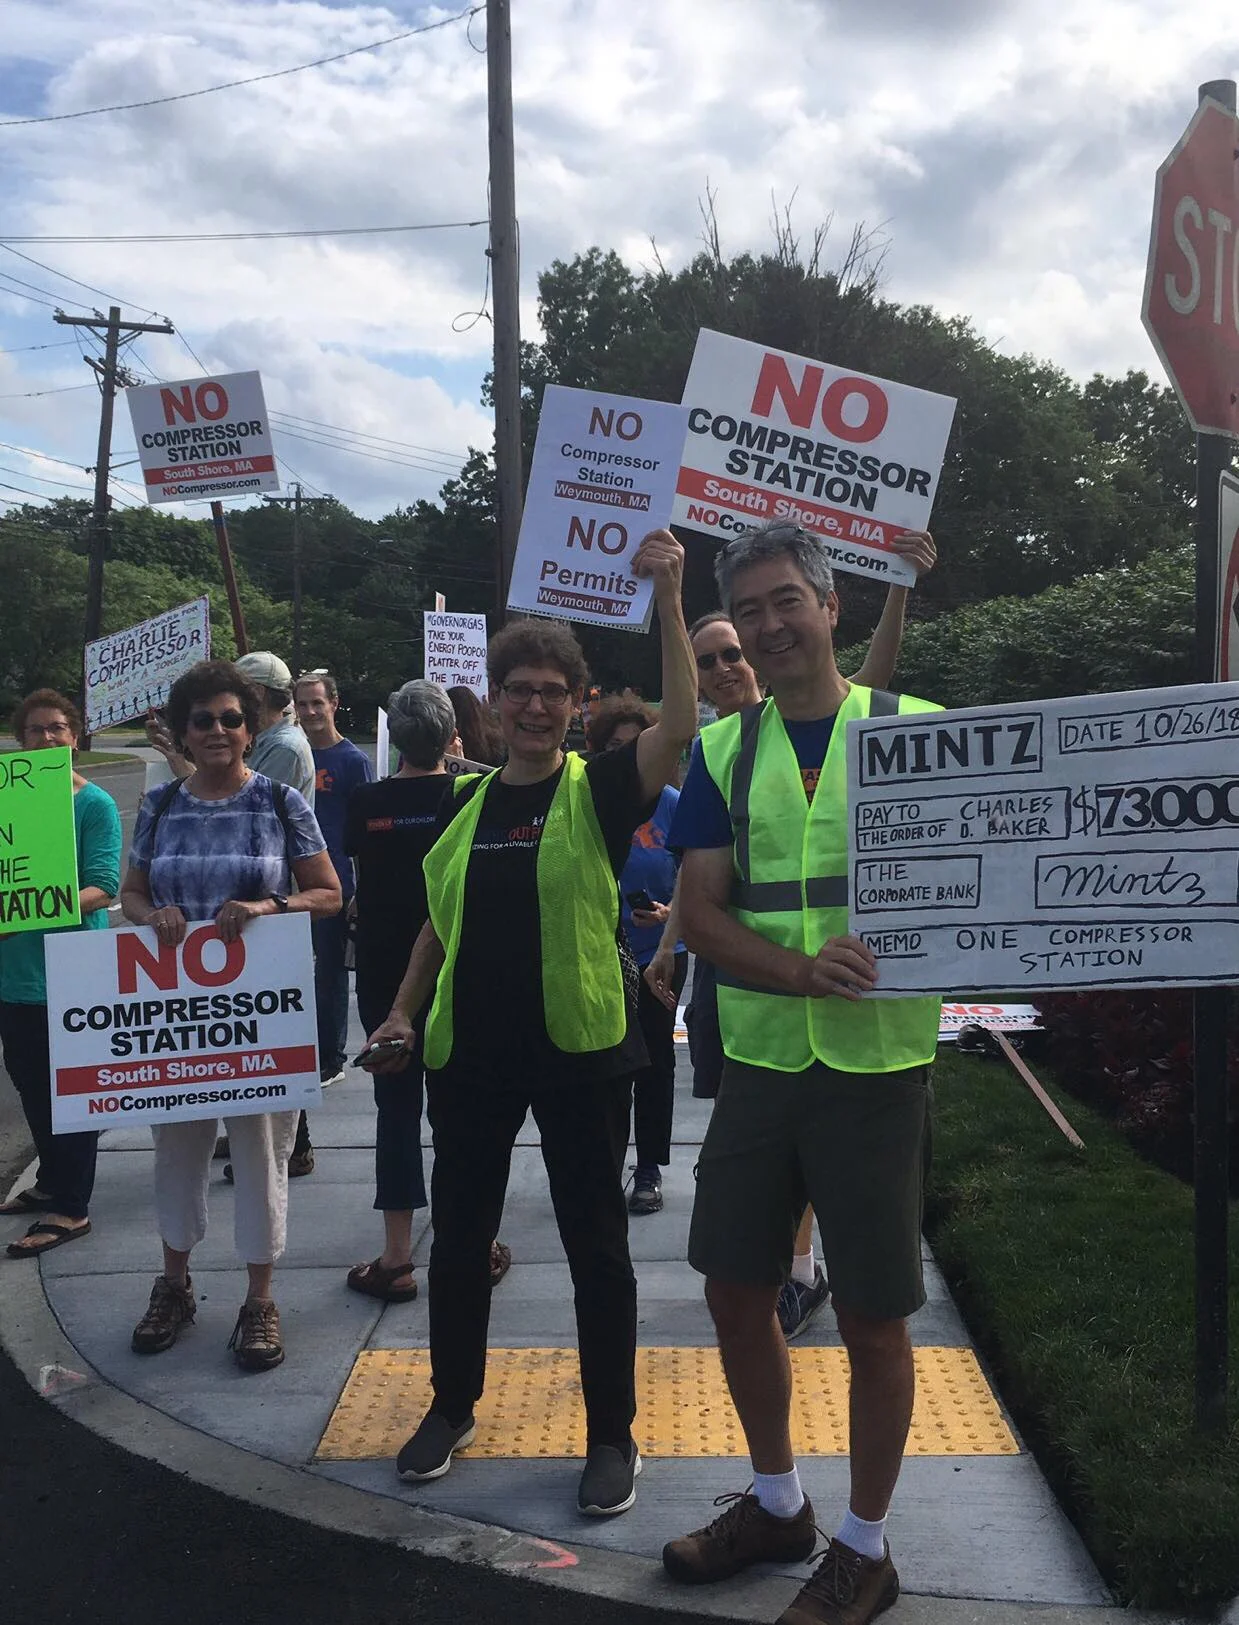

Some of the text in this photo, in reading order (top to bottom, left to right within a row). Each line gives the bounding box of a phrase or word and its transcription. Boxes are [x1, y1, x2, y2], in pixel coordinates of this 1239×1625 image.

[160, 382, 229, 426] NO
[750, 352, 889, 443] NO
[142, 421, 263, 448] COMPRESSOR
[588, 406, 643, 441] NO
[167, 440, 242, 462] STATION
[561, 443, 660, 471] Compressor
[688, 408, 932, 497] COMPRESSOR
[164, 460, 254, 480] South Shore, MA
[578, 467, 634, 488] Station
[725, 449, 879, 512] STATION
[162, 478, 261, 496] NOCompressor.com
[555, 482, 650, 509] Weymouth, MA
[704, 480, 885, 545] South Shore, MA
[566, 516, 628, 555] NO
[540, 560, 638, 596] Permits
[538, 590, 630, 614] Weymouth, MA
[98, 620, 181, 665] CHARLIE
[427, 630, 465, 641] TAKE YOUR
[428, 641, 486, 657] ENERGY POOPOO
[87, 629, 202, 688] COMPRESSOR
[428, 656, 479, 671] PLATTER OFF
[430, 672, 482, 686] THE TABLE!!
[1064, 705, 1239, 748] DATE 10/26/18
[867, 722, 1038, 776] MINTZ
[960, 796, 1054, 820] CHARLES
[860, 825, 947, 847] THE ORDER OF
[960, 818, 1051, 839] D. BAKER
[862, 863, 909, 882] THE
[1044, 856, 1206, 905] Mintz
[859, 882, 976, 905] CORPORATE BANK
[865, 926, 1193, 954] MEMO ONE COMPRESSOR
[116, 924, 246, 994] NO
[1020, 949, 1143, 974] STATION
[62, 988, 304, 1032] COMPRESSOR
[941, 1005, 1004, 1015] NO
[110, 1019, 258, 1057] STATION
[97, 1054, 277, 1086] South Shore, MA
[88, 1084, 287, 1114] NOCompressor.com
